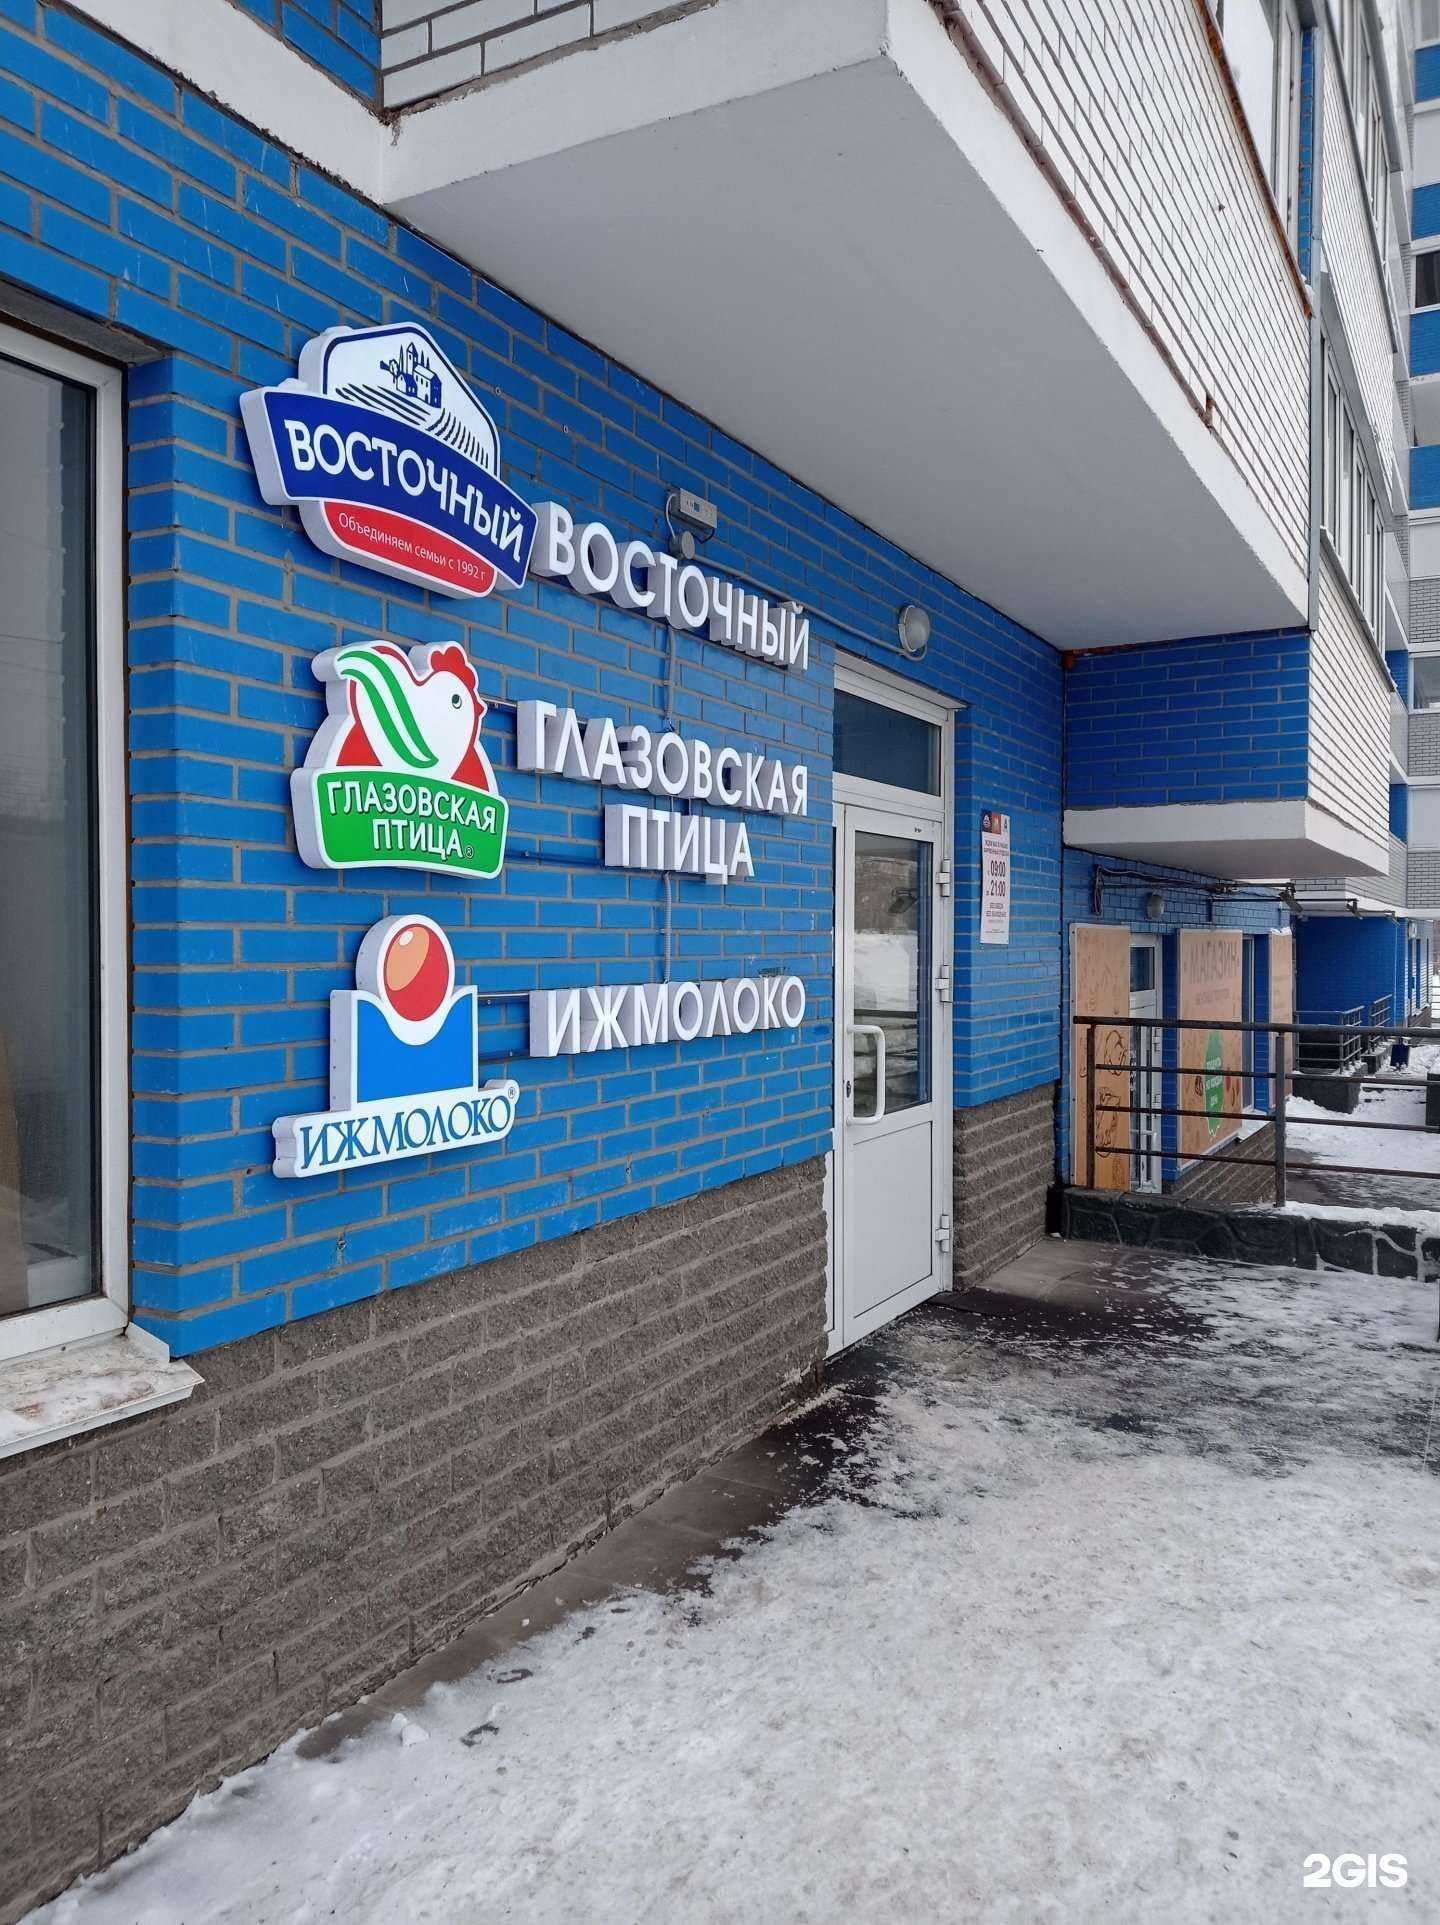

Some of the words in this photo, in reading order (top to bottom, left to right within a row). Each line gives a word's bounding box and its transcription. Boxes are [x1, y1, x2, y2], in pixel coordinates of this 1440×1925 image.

[283, 418, 525, 563] ВОСТОЧНЫЙ
[338, 512, 413, 554] Объединяем
[414, 544, 447, 567] семьи
[448, 558, 455, 570] с
[457, 559, 479, 579] 1992
[546, 500, 810, 671] ВОСТОЧНЫЙ
[532, 700, 808, 816] ГЛАЗОВСКАЯ
[326, 780, 498, 836] ГЛАЗОВСКАЯ
[371, 819, 466, 862] ПТИЦА
[618, 804, 755, 884] ПТИЦА
[990, 860, 1006, 877] 09:00
[990, 880, 1006, 897] 21:00
[545, 975, 806, 1057] ИЖМОЛОКО
[299, 1093, 512, 1172] ИЖМОЛОКО
